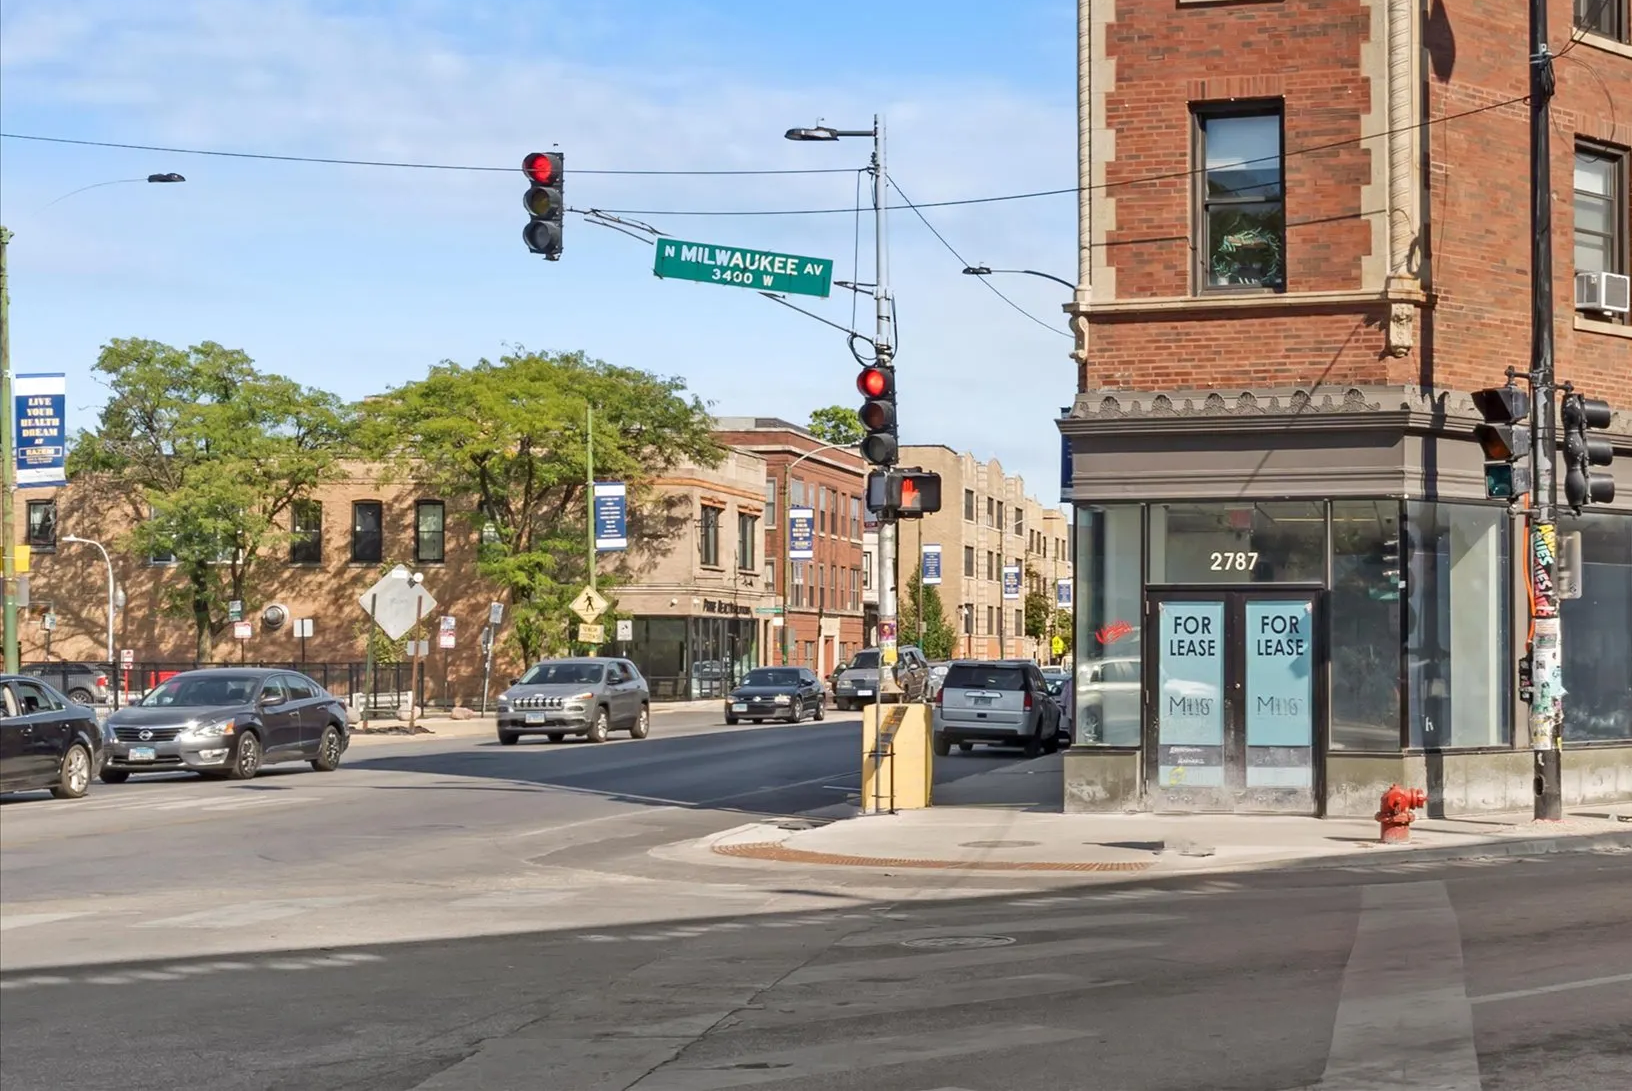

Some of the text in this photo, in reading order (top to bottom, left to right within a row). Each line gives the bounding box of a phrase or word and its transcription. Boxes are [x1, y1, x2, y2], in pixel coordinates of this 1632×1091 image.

[664, 244, 823, 276] N MILWAUKEE AV
[711, 268, 774, 287] 3400 W
[28, 397, 52, 407] LIVE
[26, 407, 54, 417] YOUR
[20, 417, 60, 428] HEALTH
[22, 428, 58, 438] DREAM
[1210, 552, 1259, 571] 2787
[1174, 616, 1211, 634] FOR
[1261, 615, 1299, 634] FOR
[1169, 639, 1215, 656] LEASE
[1257, 639, 1304, 656] LEASE
